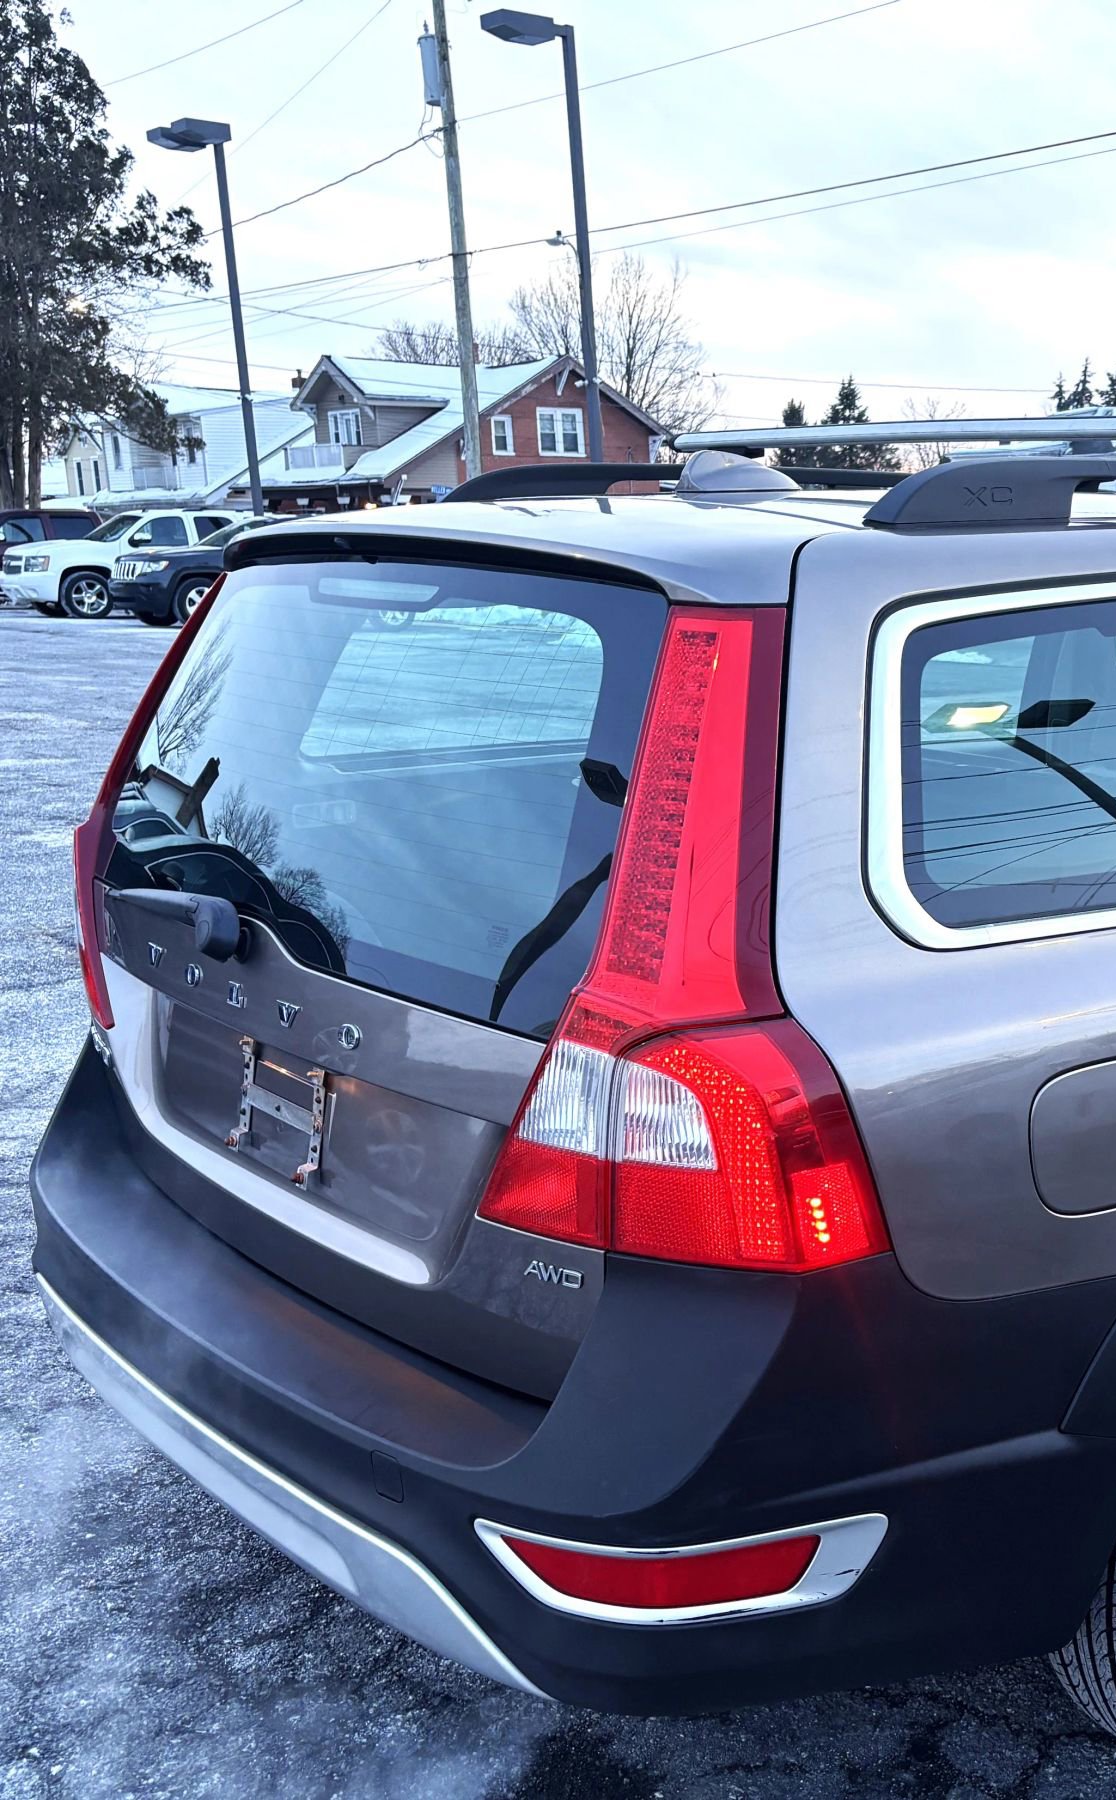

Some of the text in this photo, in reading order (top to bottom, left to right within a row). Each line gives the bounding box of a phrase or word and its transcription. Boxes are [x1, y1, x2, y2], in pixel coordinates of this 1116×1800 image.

[962, 486, 1013, 507] XC
[148, 942, 363, 1050] VOLVO
[523, 1260, 584, 1289] AWD
